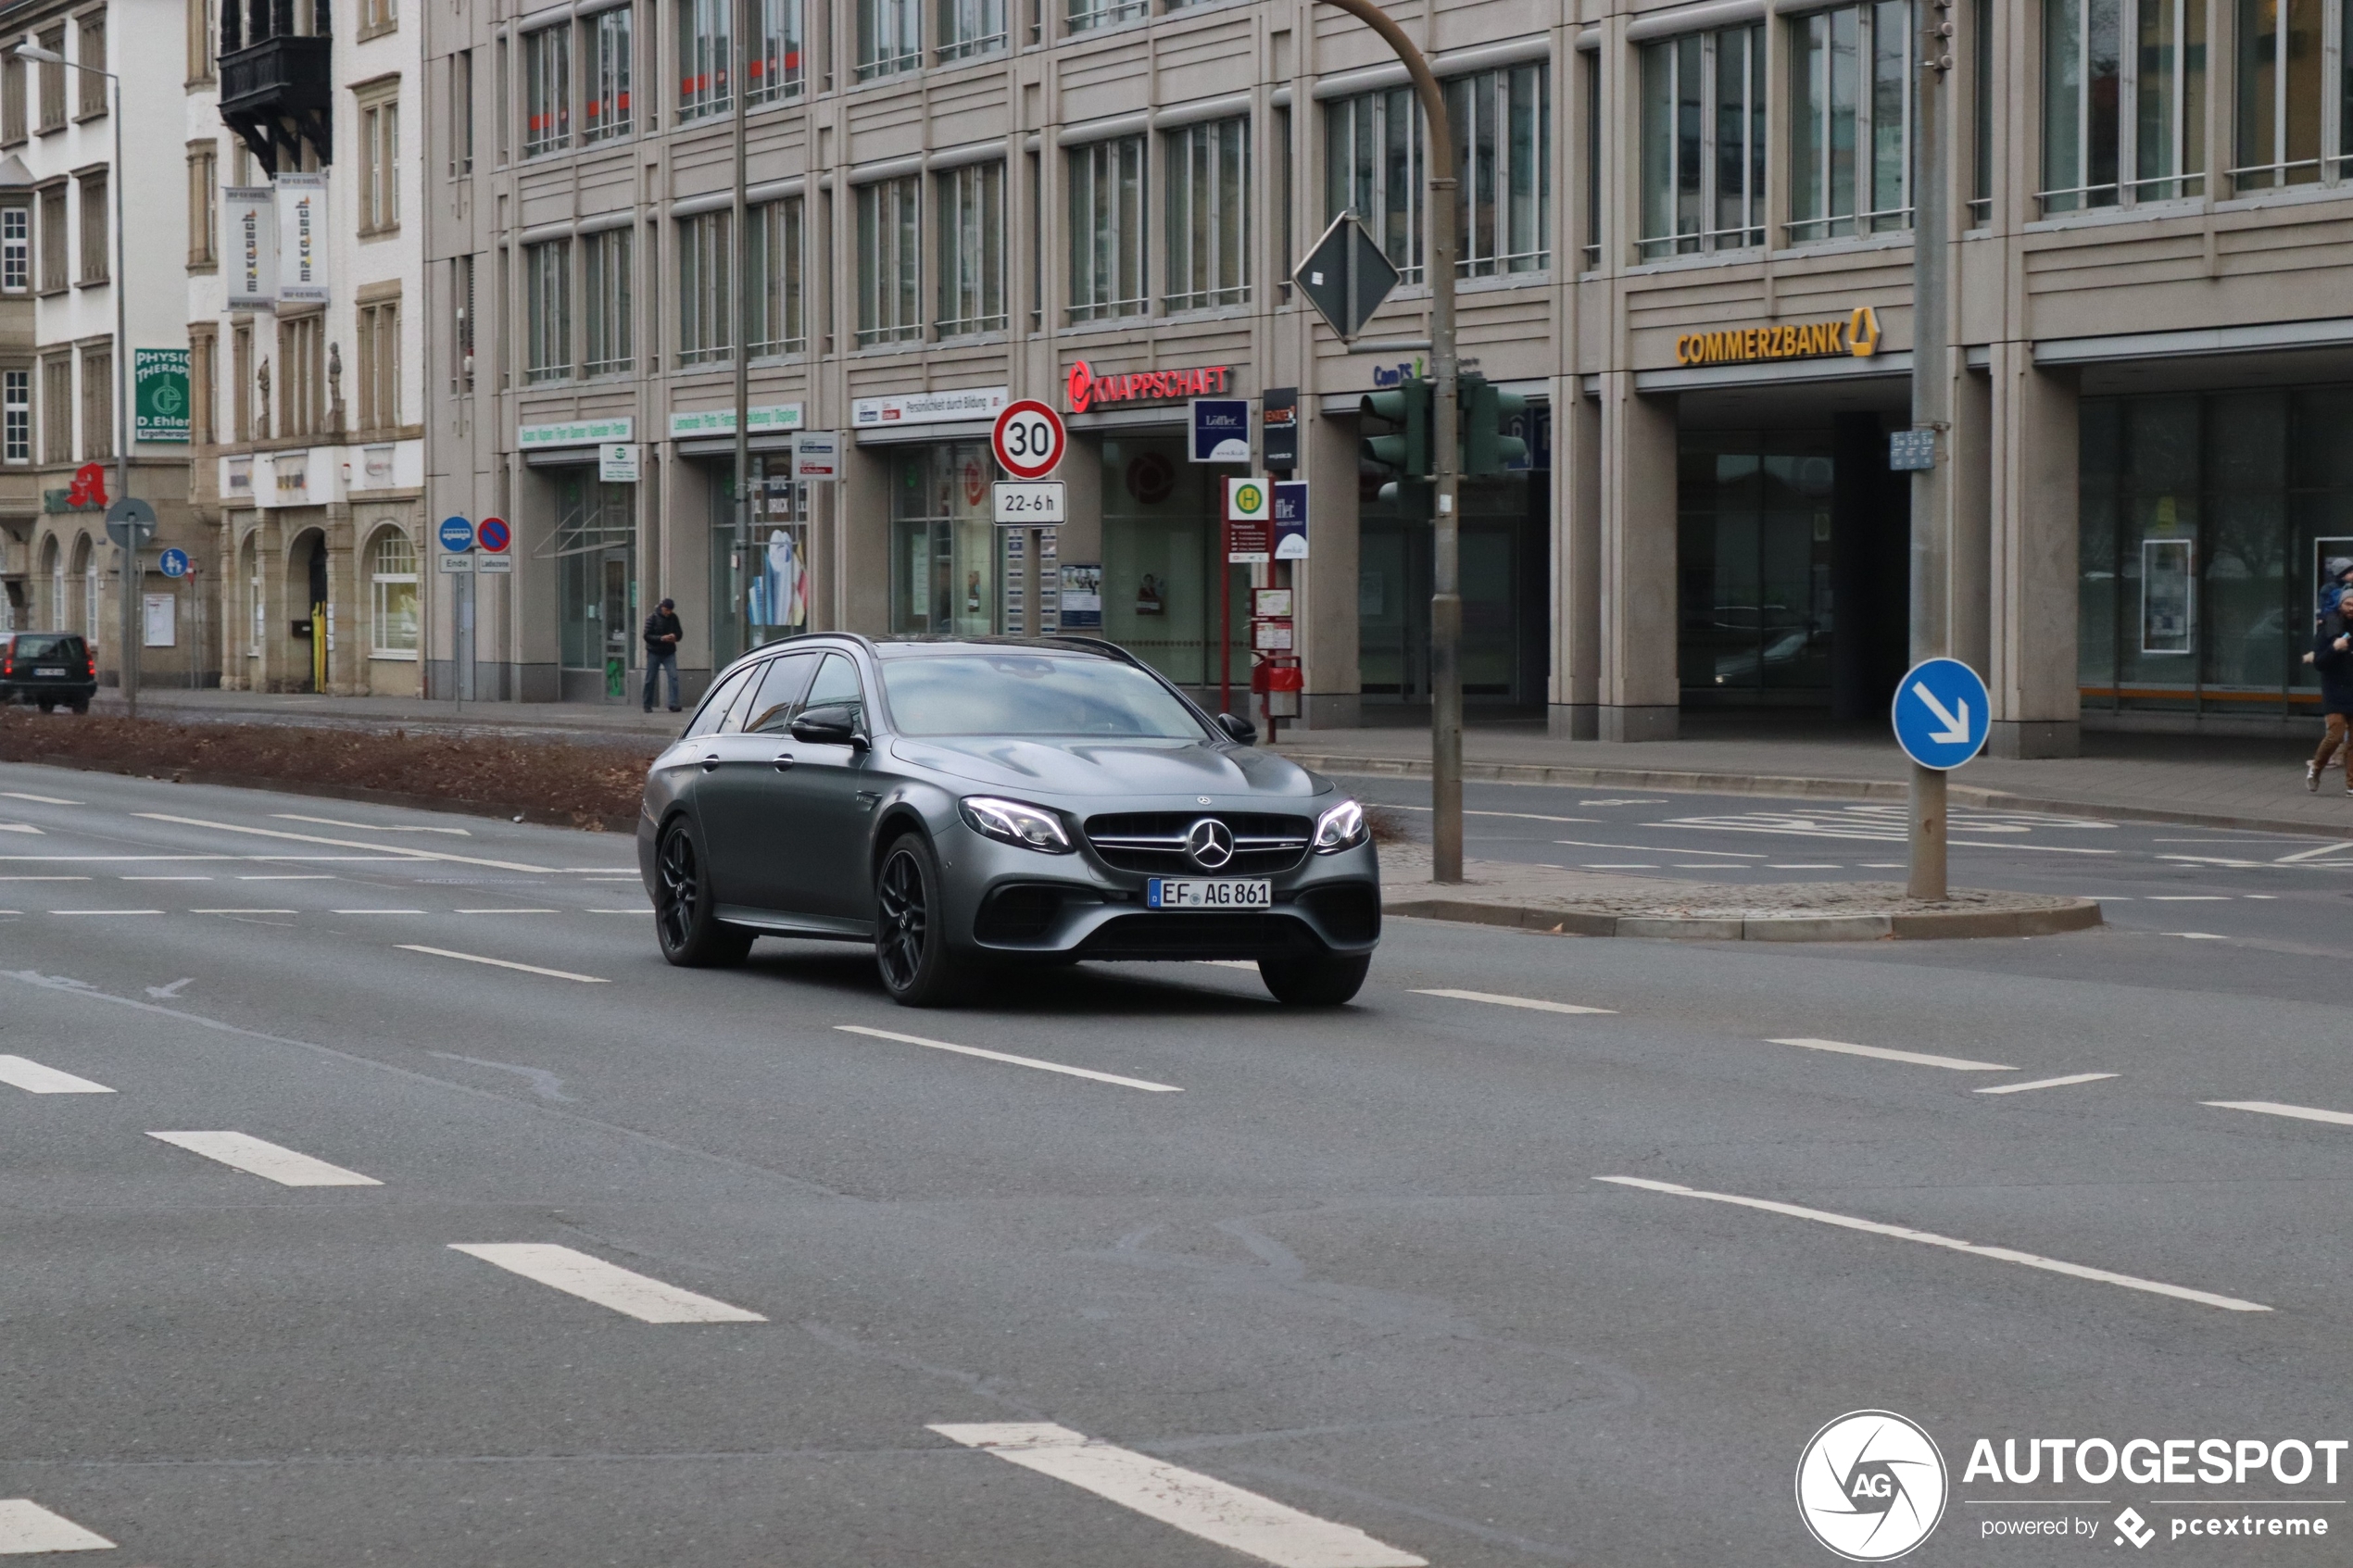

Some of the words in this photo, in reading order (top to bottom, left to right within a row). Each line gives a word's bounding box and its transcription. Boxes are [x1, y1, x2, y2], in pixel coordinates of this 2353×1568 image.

[1676, 321, 1844, 364] COMMERZBANK
[136, 364, 190, 383] THERAPI
[1092, 366, 1227, 403] KNAPPSCHAFT
[906, 399, 945, 414] Persönlichkeit
[947, 397, 963, 410] durch
[964, 395, 987, 411] Bildung
[137, 416, 191, 426] D.Ehler
[141, 430, 191, 439] Ergotherapi
[1009, 421, 1049, 457] 30
[447, 559, 468, 568] Ende
[1163, 883, 1190, 904] EF
[1205, 883, 1230, 904] AG
[1235, 883, 1269, 904] 861
